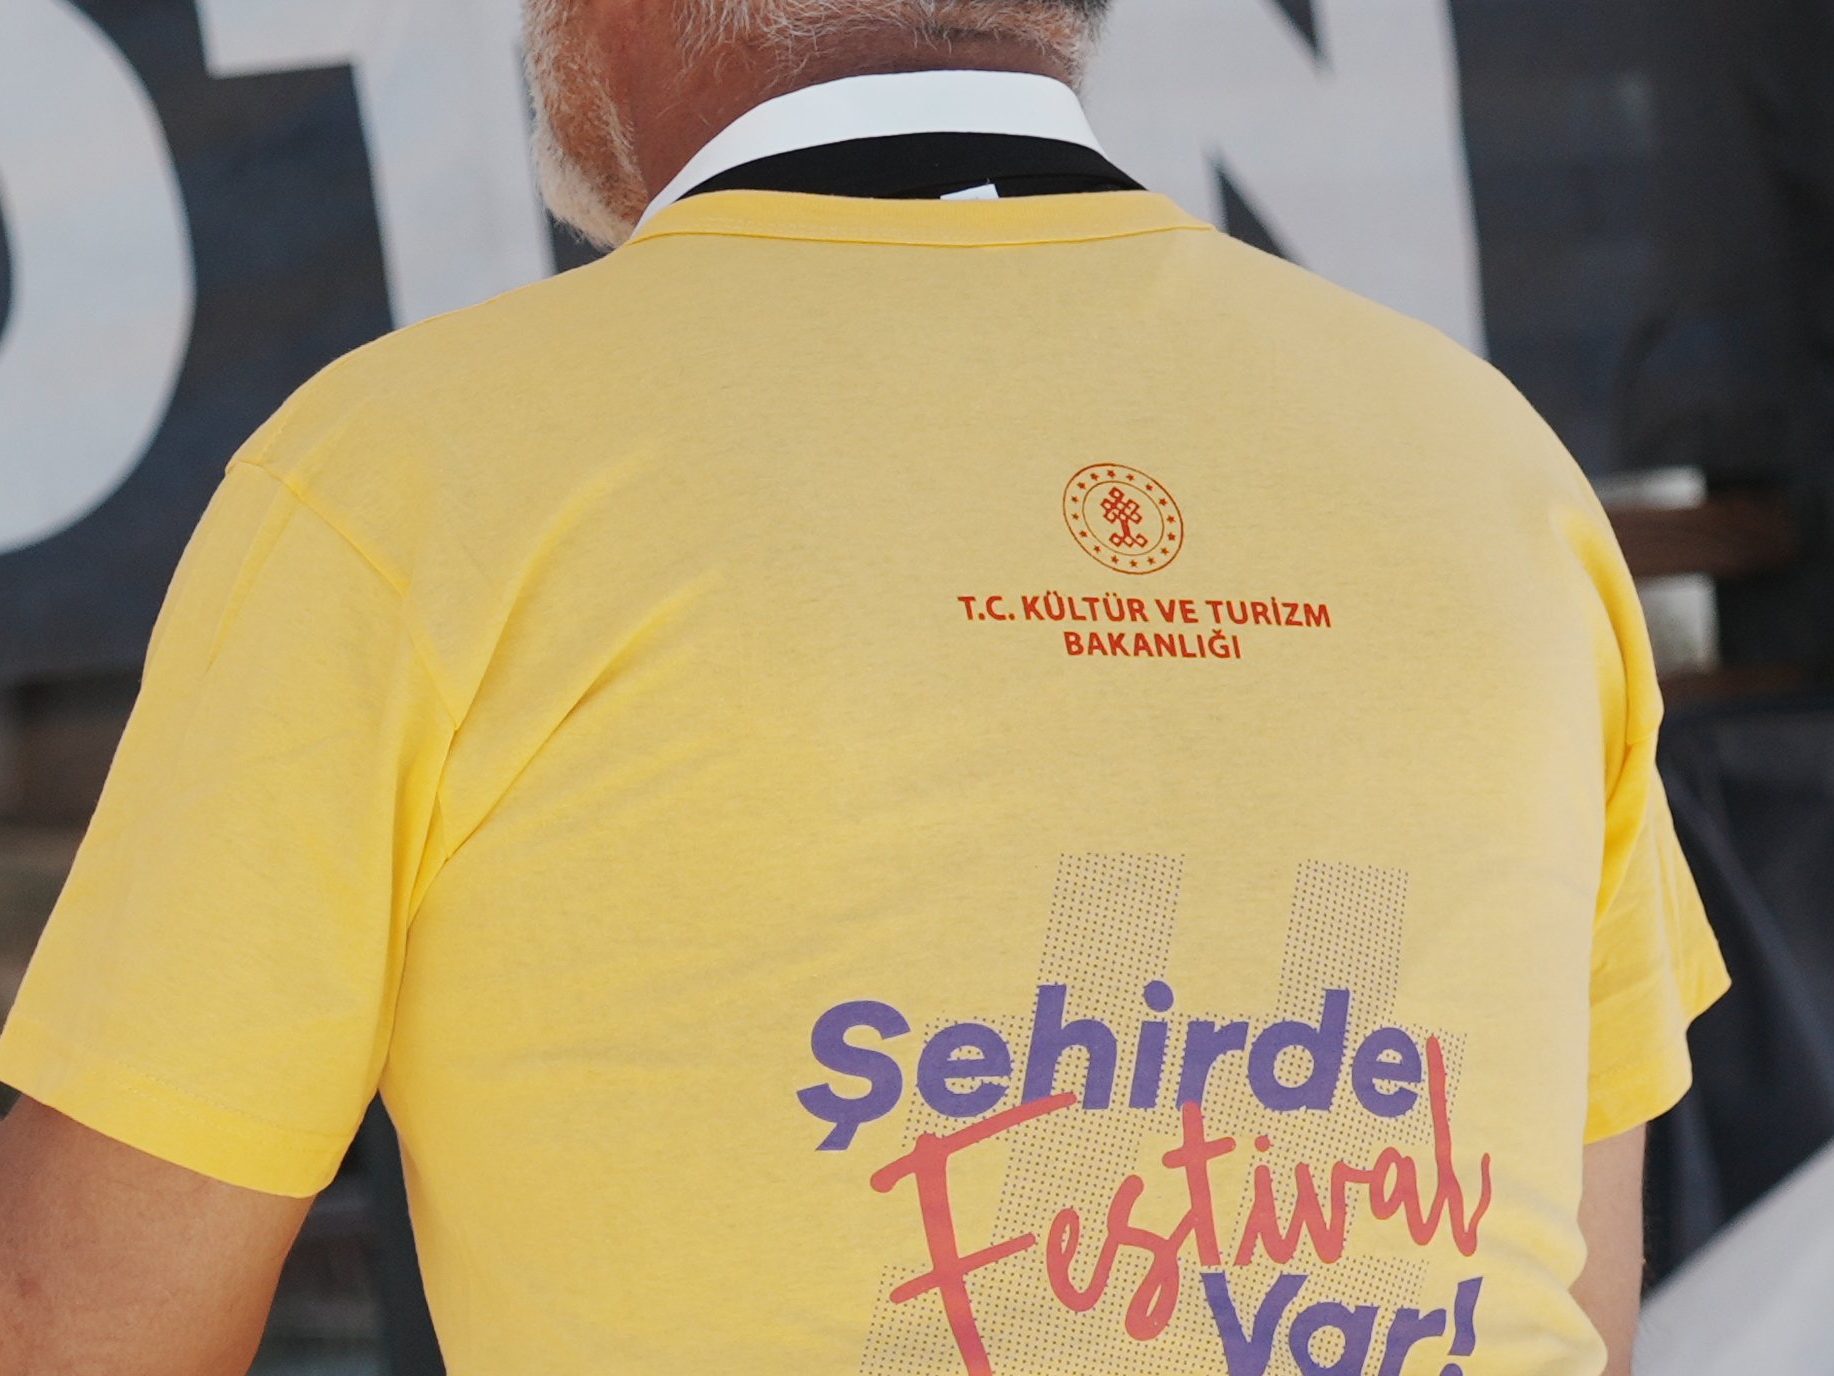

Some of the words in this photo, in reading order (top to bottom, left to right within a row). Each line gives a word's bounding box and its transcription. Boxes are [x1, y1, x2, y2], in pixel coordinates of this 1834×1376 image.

[957, 595, 1016, 621] T.C.
[1021, 590, 1150, 623] KÜLTÜR
[1155, 597, 1200, 624] VE
[1205, 595, 1333, 628] TURİZM
[1062, 628, 1243, 660] BAKANLIĞI
[796, 978, 1425, 1153] Şehirde
